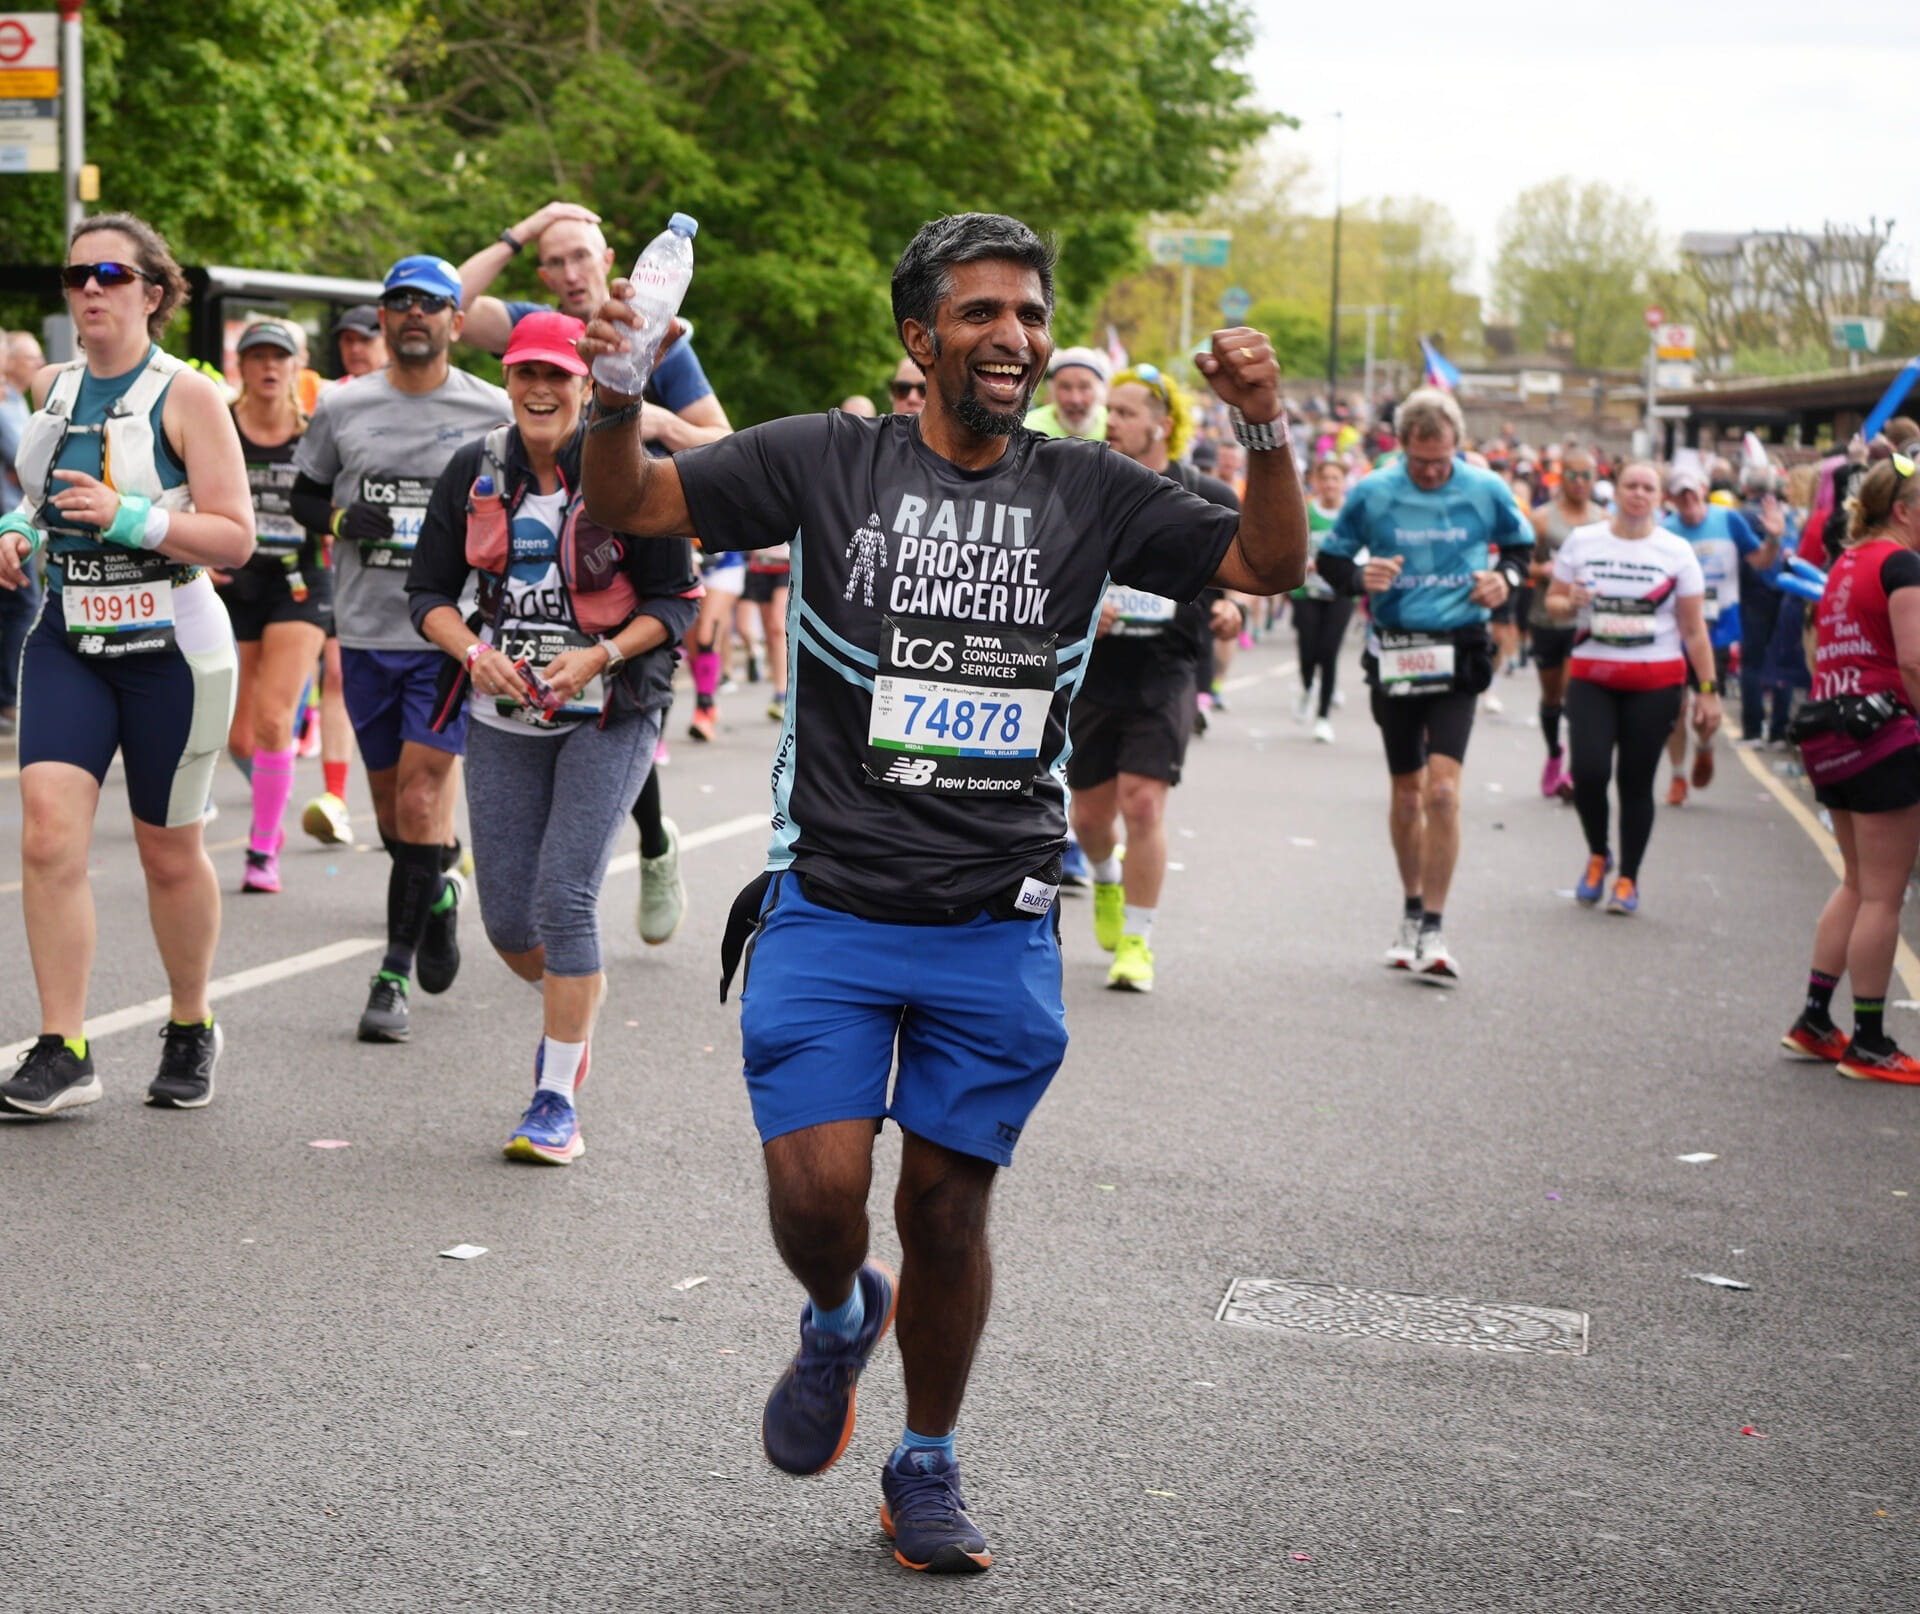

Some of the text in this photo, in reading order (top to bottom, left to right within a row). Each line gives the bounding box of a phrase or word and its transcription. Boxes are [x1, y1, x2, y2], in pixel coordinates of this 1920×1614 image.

[395, 516, 424, 539] 44
[892, 493, 1032, 548] RAJIT
[512, 537, 549, 549] tizens
[895, 536, 1041, 586] PROSTATE
[80, 592, 155, 622] 19919
[889, 575, 1051, 625] CANCER UK
[105, 644, 126, 654] new
[126, 638, 166, 652] balance
[890, 627, 956, 672] tcs
[964, 635, 1002, 650] TATA
[961, 649, 1048, 667] CONSULTANCY
[959, 663, 1017, 679] SERVICES
[903, 694, 1023, 743] 74878
[904, 743, 924, 751] MEDAL
[771, 733, 795, 805] CANC
[935, 776, 965, 789] new
[967, 777, 1022, 791] balance
[1022, 892, 1052, 909] BUXTO
